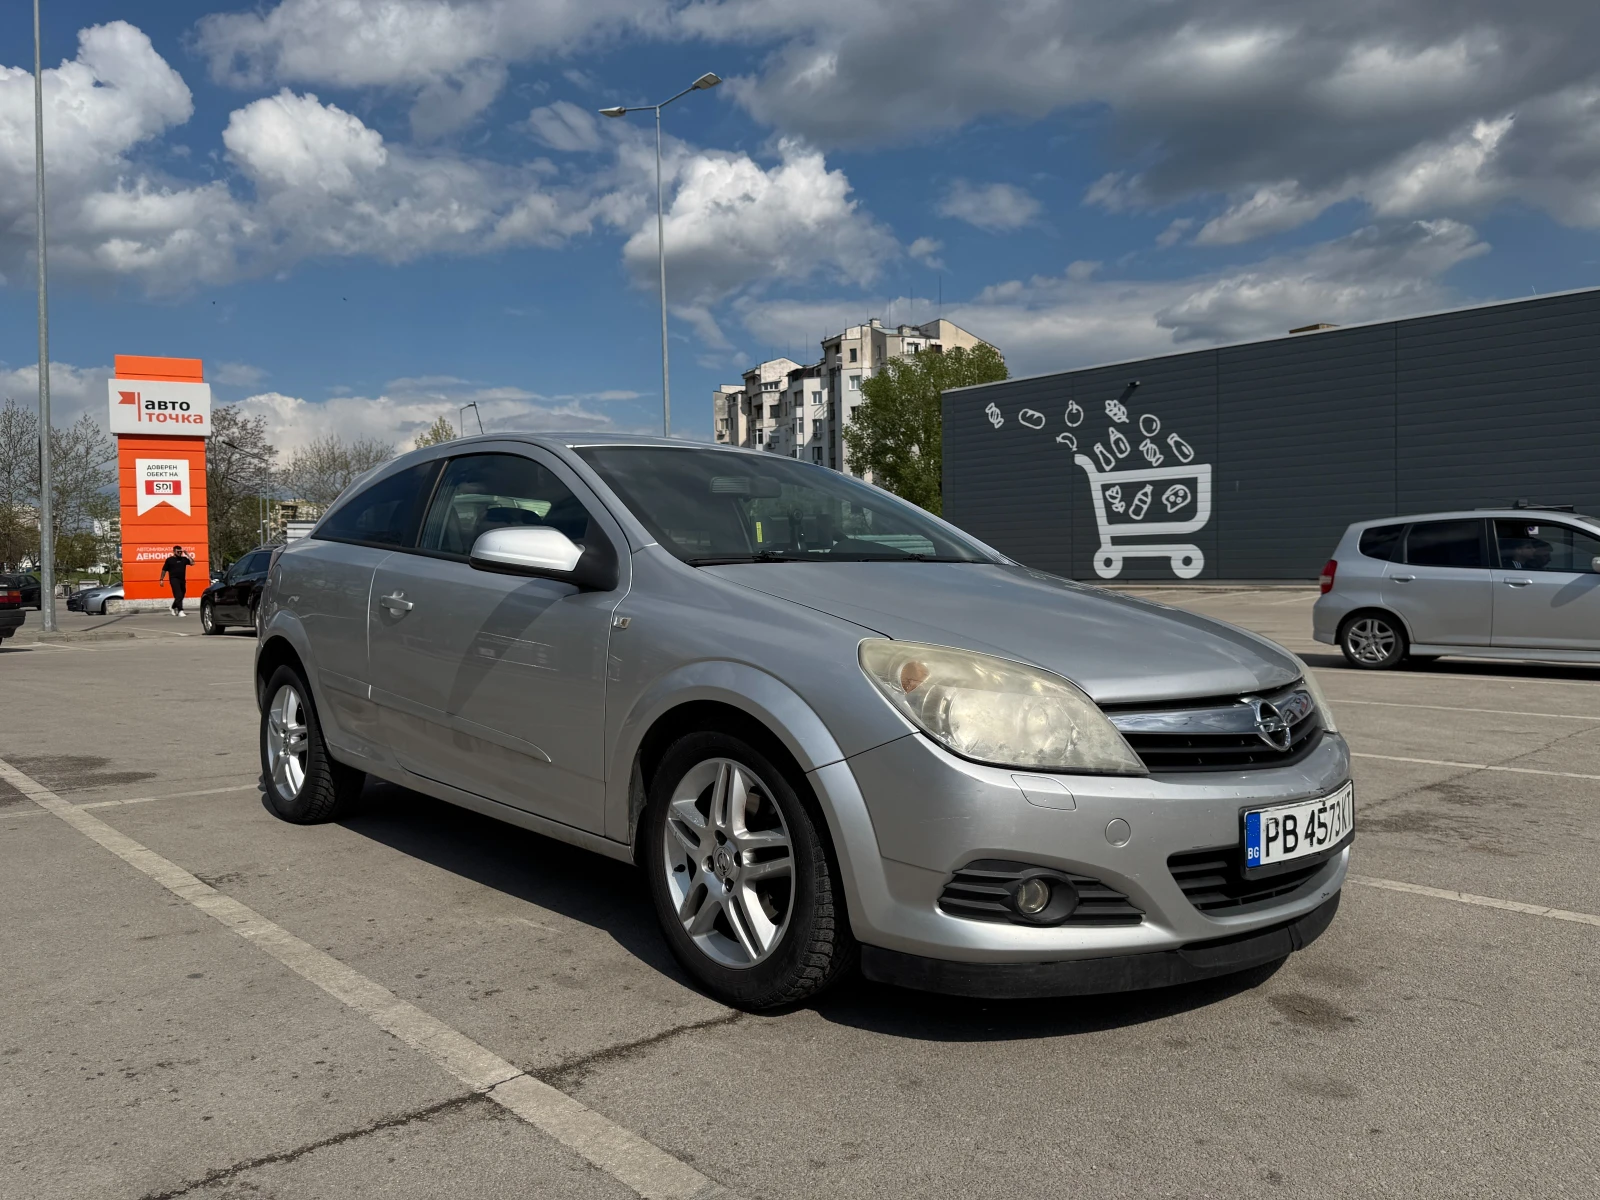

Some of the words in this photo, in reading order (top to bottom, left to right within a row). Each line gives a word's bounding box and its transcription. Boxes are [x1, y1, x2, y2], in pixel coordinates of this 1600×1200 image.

[145, 400, 190, 411] авто
[145, 413, 203, 424] точка
[1247, 847, 1259, 859] BG
[1266, 814, 1298, 857] PB
[1304, 800, 1341, 847] 4573
